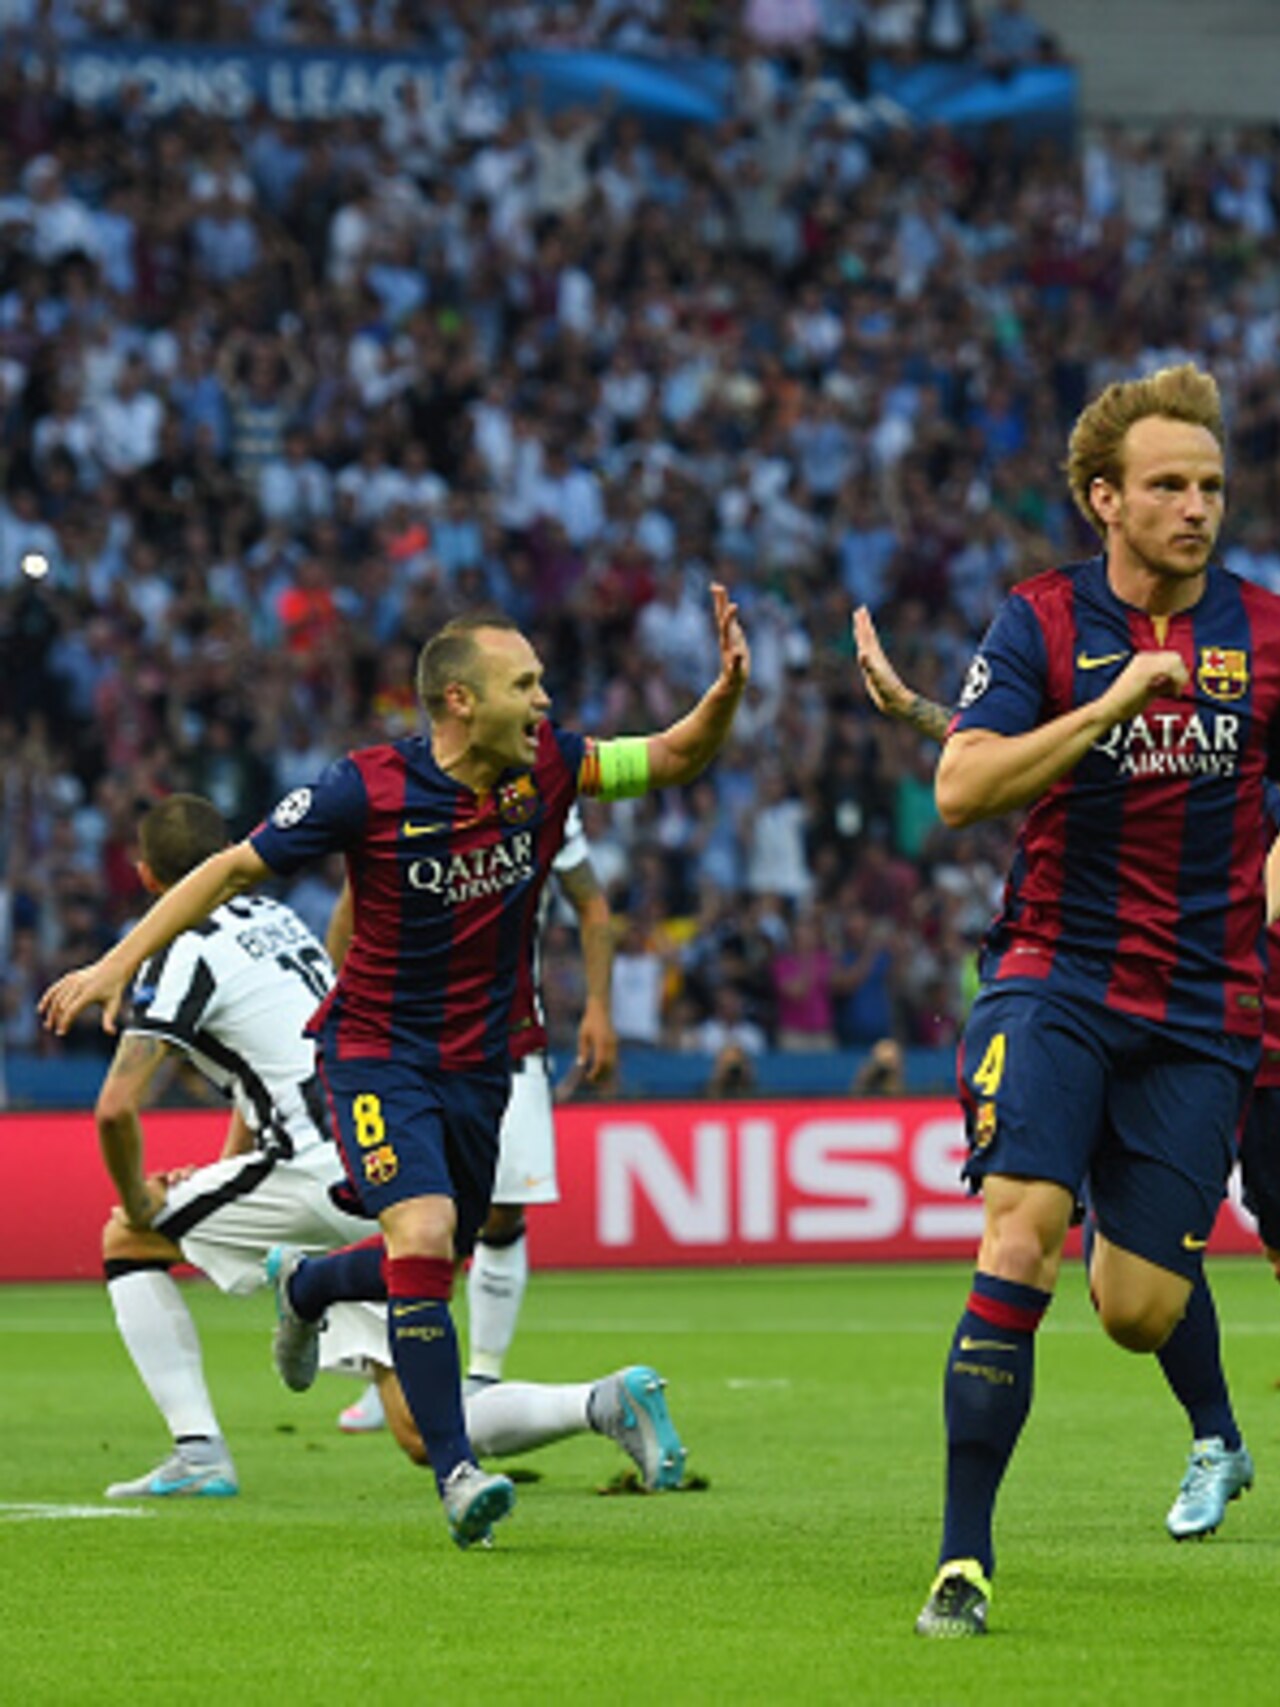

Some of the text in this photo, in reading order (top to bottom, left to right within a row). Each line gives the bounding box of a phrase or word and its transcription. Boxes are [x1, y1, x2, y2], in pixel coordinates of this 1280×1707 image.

[1116, 752, 1237, 777] AIRWAYS
[408, 831, 532, 894] QATAR
[973, 1032, 1006, 1096] 4
[353, 1093, 386, 1147] 8
[597, 1117, 985, 1246] NISS
